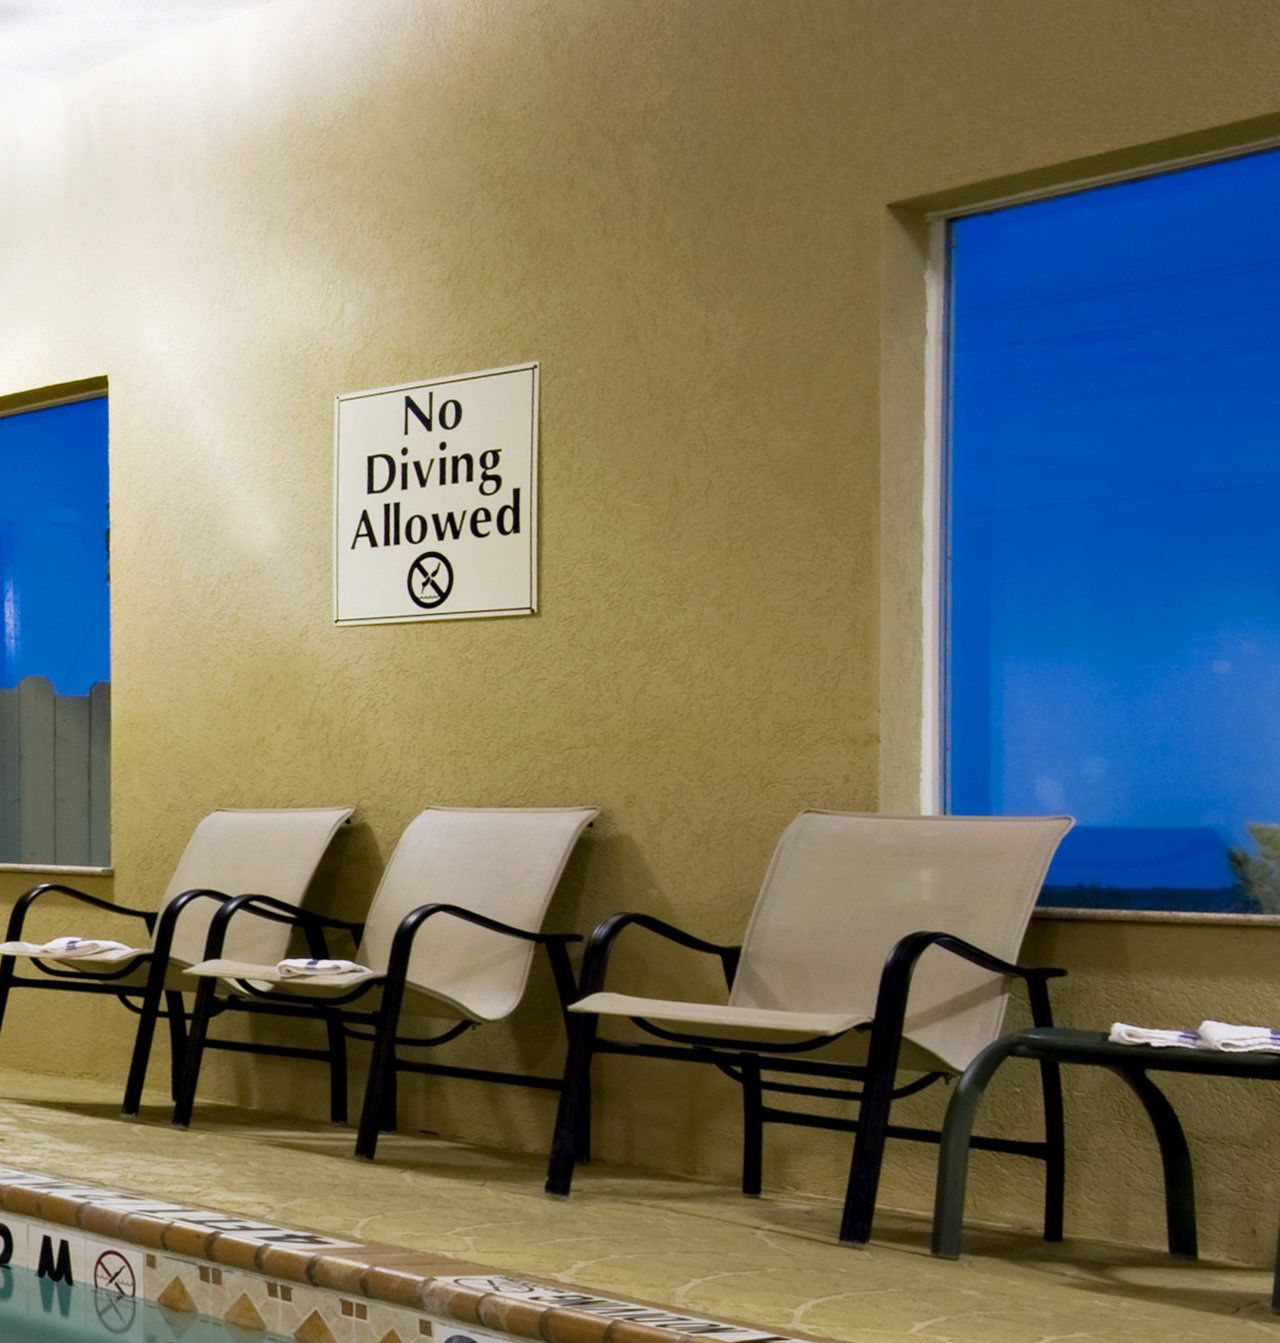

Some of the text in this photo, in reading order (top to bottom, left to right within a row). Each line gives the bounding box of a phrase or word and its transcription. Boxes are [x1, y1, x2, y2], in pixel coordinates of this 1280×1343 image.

[404, 391, 463, 436] No
[366, 441, 503, 496] Diving
[351, 487, 521, 550] Allowed
[38, 1235, 73, 1286] M
[254, 1234, 334, 1244] 4
